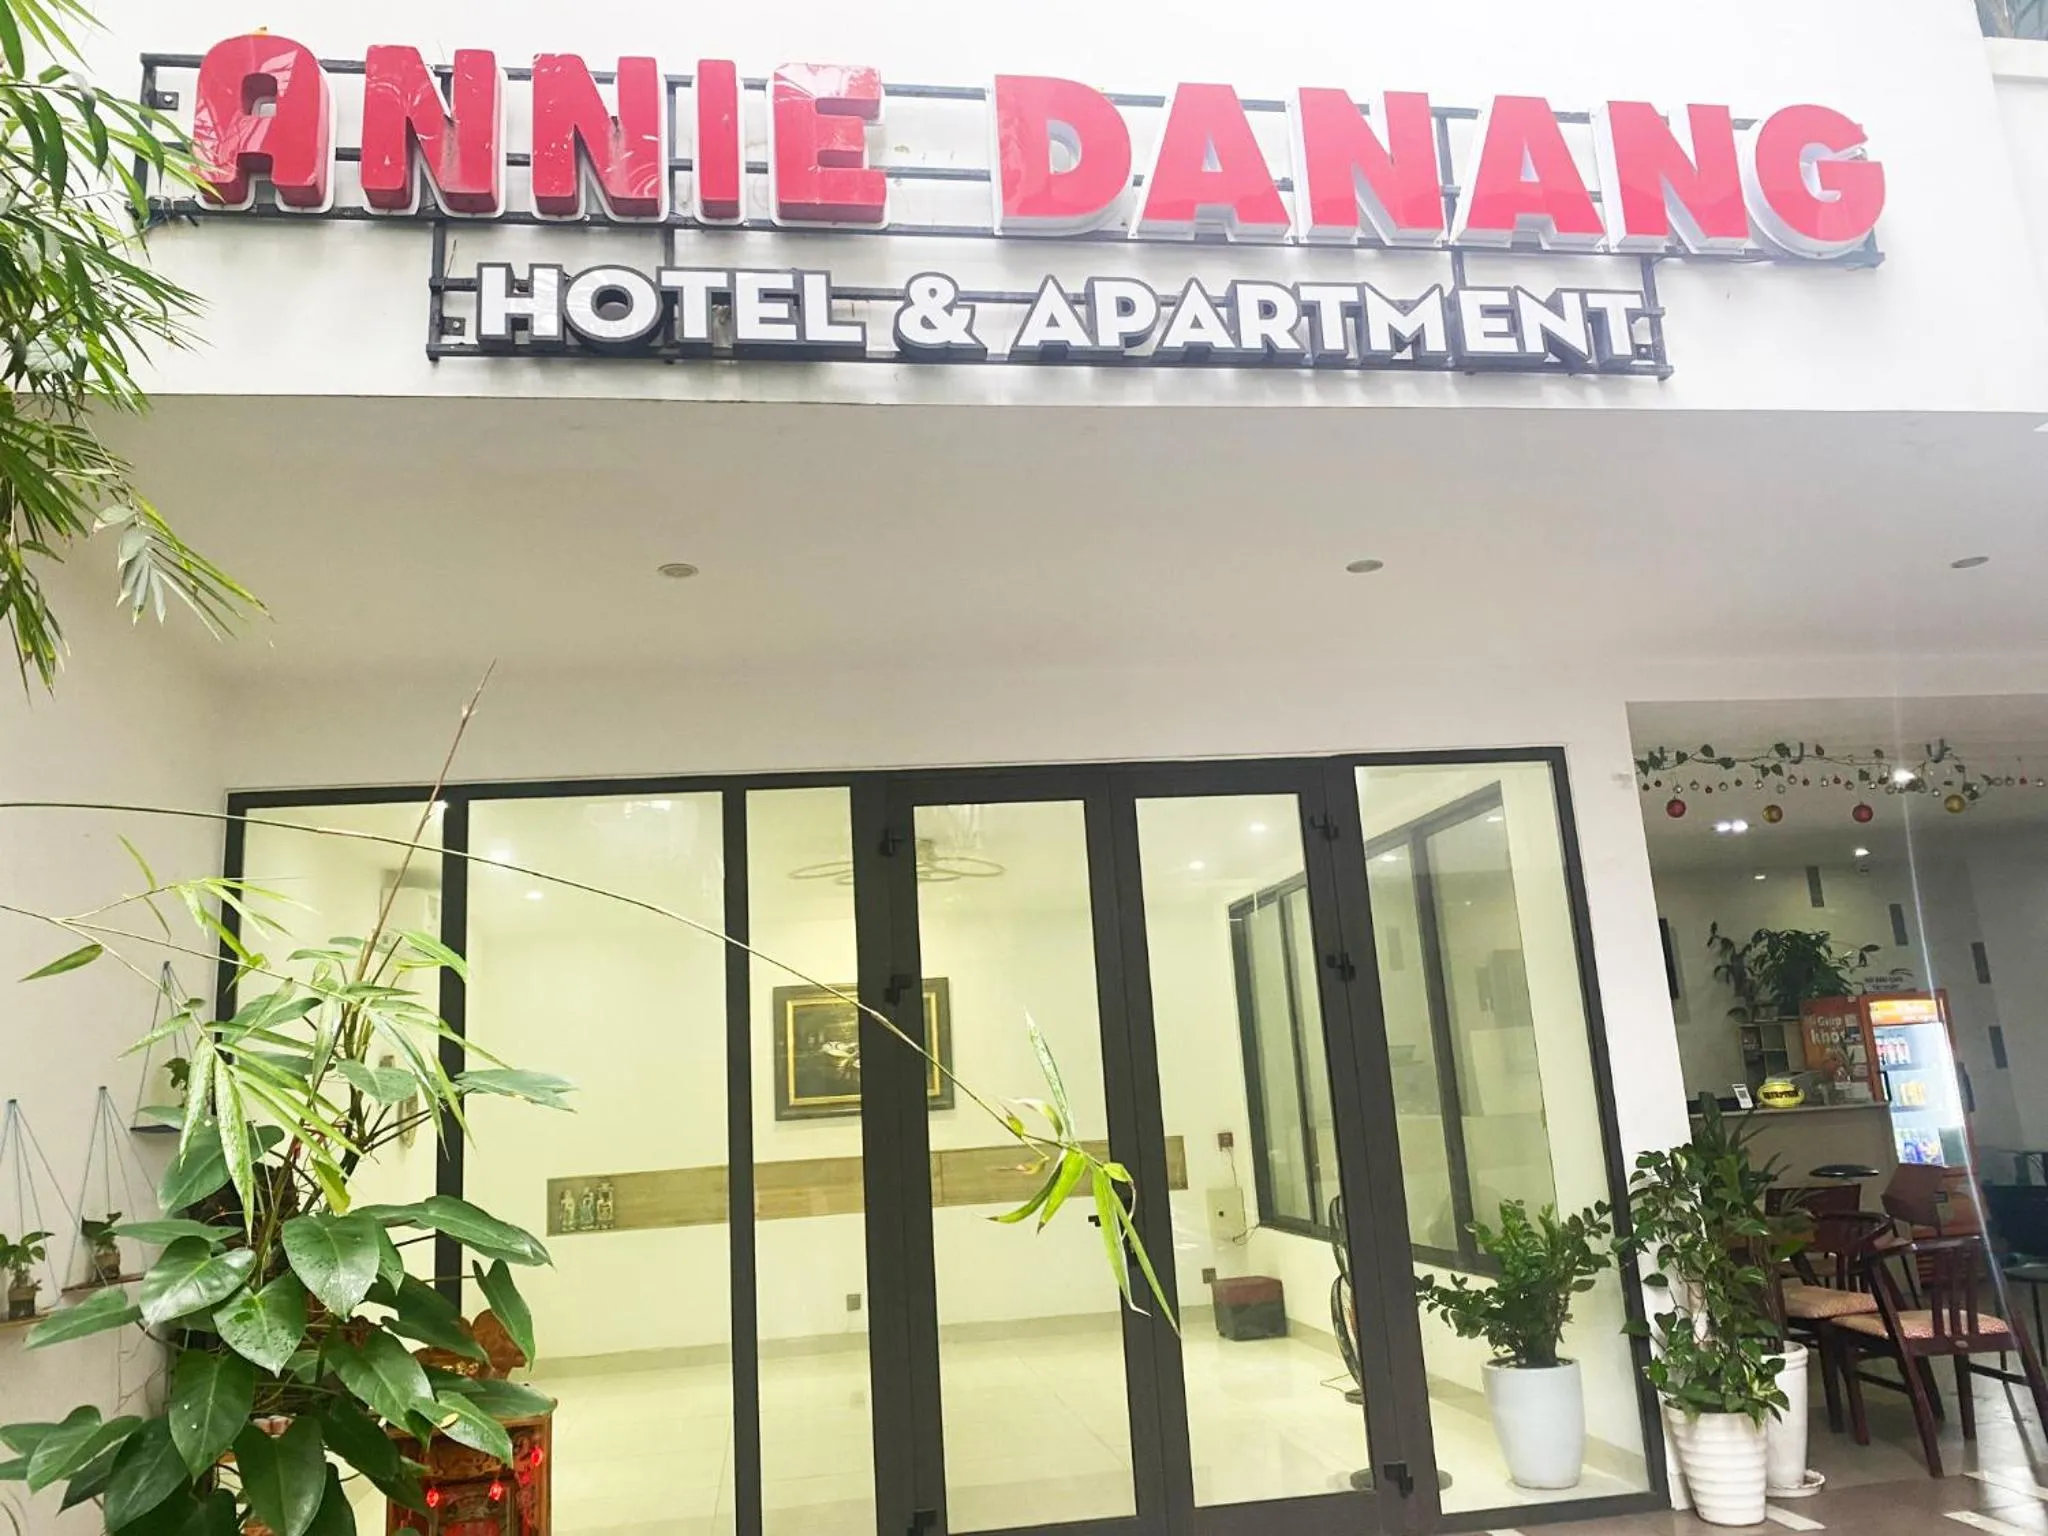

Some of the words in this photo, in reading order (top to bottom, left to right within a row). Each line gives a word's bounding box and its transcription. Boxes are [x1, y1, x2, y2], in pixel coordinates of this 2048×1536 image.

[191, 33, 888, 226] ANNIE
[993, 74, 1886, 256] DANANG
[478, 263, 866, 356] HOTEL
[894, 272, 986, 358] &
[1010, 275, 1646, 366] APARTMENT
